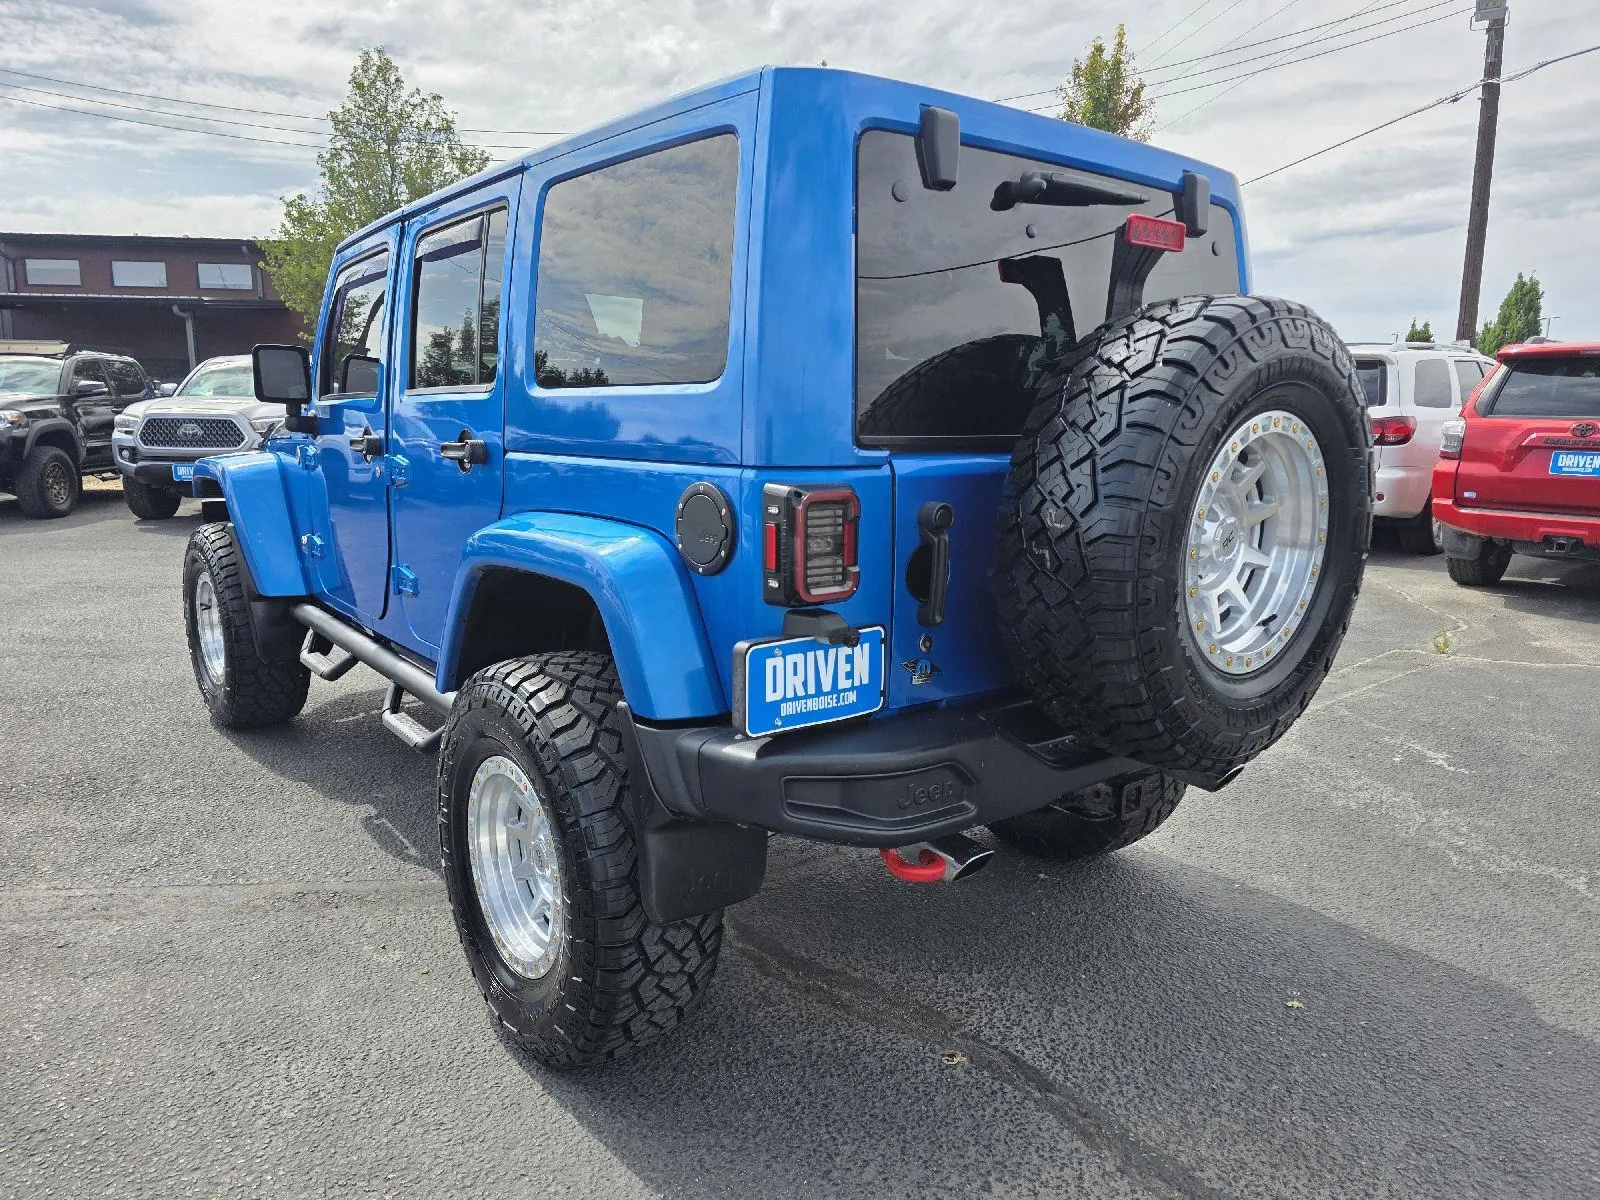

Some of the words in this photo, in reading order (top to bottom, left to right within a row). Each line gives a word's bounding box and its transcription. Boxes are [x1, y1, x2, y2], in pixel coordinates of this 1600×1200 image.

[177, 466, 194, 476] DRIV
[1557, 454, 1600, 468] DRIVEN
[766, 643, 870, 703] DRIVEN
[780, 690, 857, 717] DRIVENBOISE.COM
[897, 781, 954, 809] Jeep
